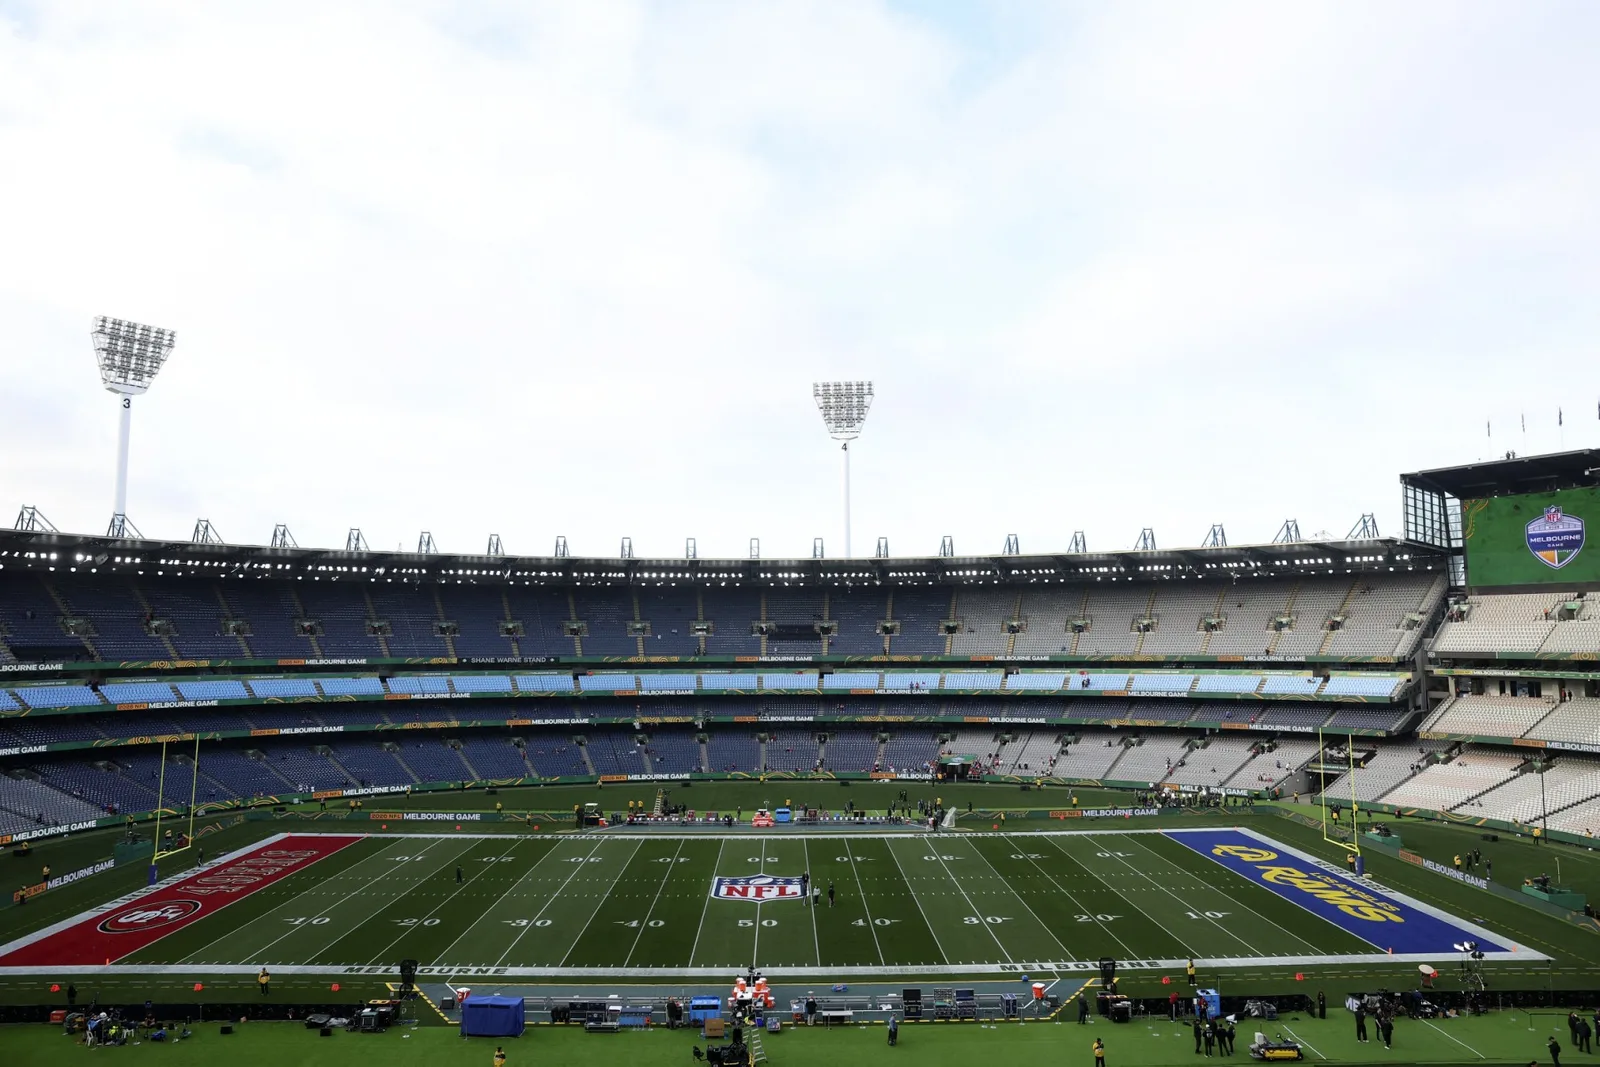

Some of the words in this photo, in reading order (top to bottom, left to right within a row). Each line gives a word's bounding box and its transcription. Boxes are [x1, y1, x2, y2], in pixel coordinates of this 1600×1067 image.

[123, 398, 131, 409] 3
[841, 442, 848, 452] 4
[1546, 513, 1561, 521] NFL
[1530, 535, 1581, 543] MELBOURNE
[149, 701, 194, 709] MELBOURNE
[280, 726, 323, 735] MELBOURNE
[1249, 724, 1291, 732] MELBOURNE
[21, 745, 47, 754] GAME
[1547, 741, 1600, 753] MELBOURNE
[343, 787, 389, 796] MELBOURNE
[1226, 788, 1248, 796] GAME
[1083, 809, 1133, 817] MELBOURNE
[13, 825, 69, 842] MELBOURNE
[70, 820, 96, 831] GAME
[47, 869, 94, 890] MELBOURNE
[94, 859, 115, 874] GAME
[1422, 858, 1464, 882] MELBOURNE
[1465, 873, 1488, 890] GAME
[725, 885, 798, 899] NFL
[1255, 865, 1405, 923] RAMS
[1073, 913, 1114, 922] 20
[1185, 911, 1224, 919] 10
[287, 917, 331, 925] 10
[396, 918, 441, 926] 20
[510, 919, 552, 927] 30
[624, 919, 665, 927] 40
[737, 919, 778, 927] 50
[851, 918, 892, 926] 40
[963, 916, 1003, 925] 30
[343, 966, 509, 975] MELOURNE
